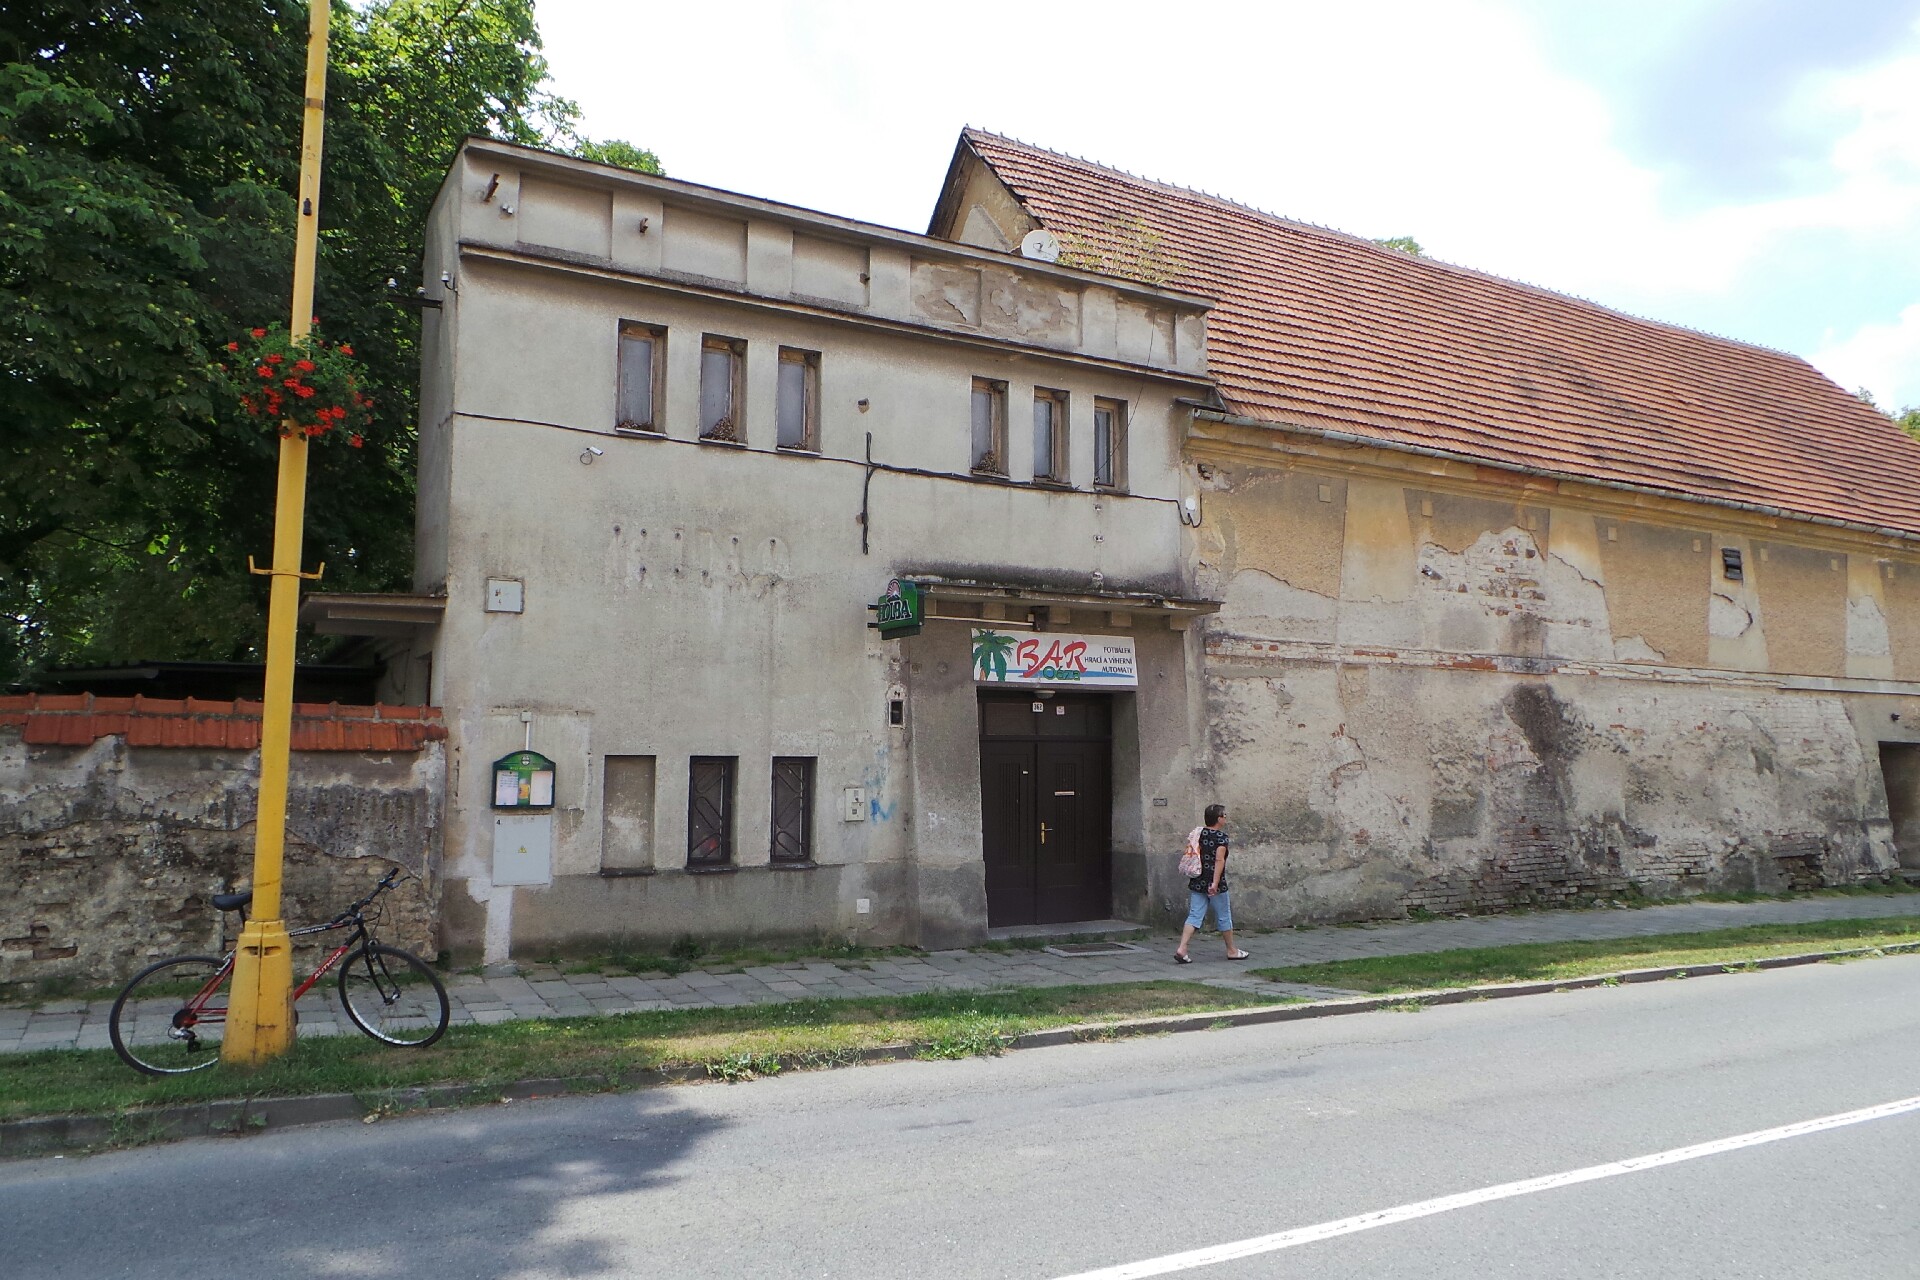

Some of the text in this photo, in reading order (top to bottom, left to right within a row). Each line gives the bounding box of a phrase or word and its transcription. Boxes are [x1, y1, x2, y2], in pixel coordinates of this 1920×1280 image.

[1017, 639, 1087, 678] BAR
[1084, 656, 1102, 664] HRACÍ
[1102, 666, 1133, 674] AUTOMATY
[1034, 703, 1043, 711] 362
[314, 950, 342, 979] AUTHOR
